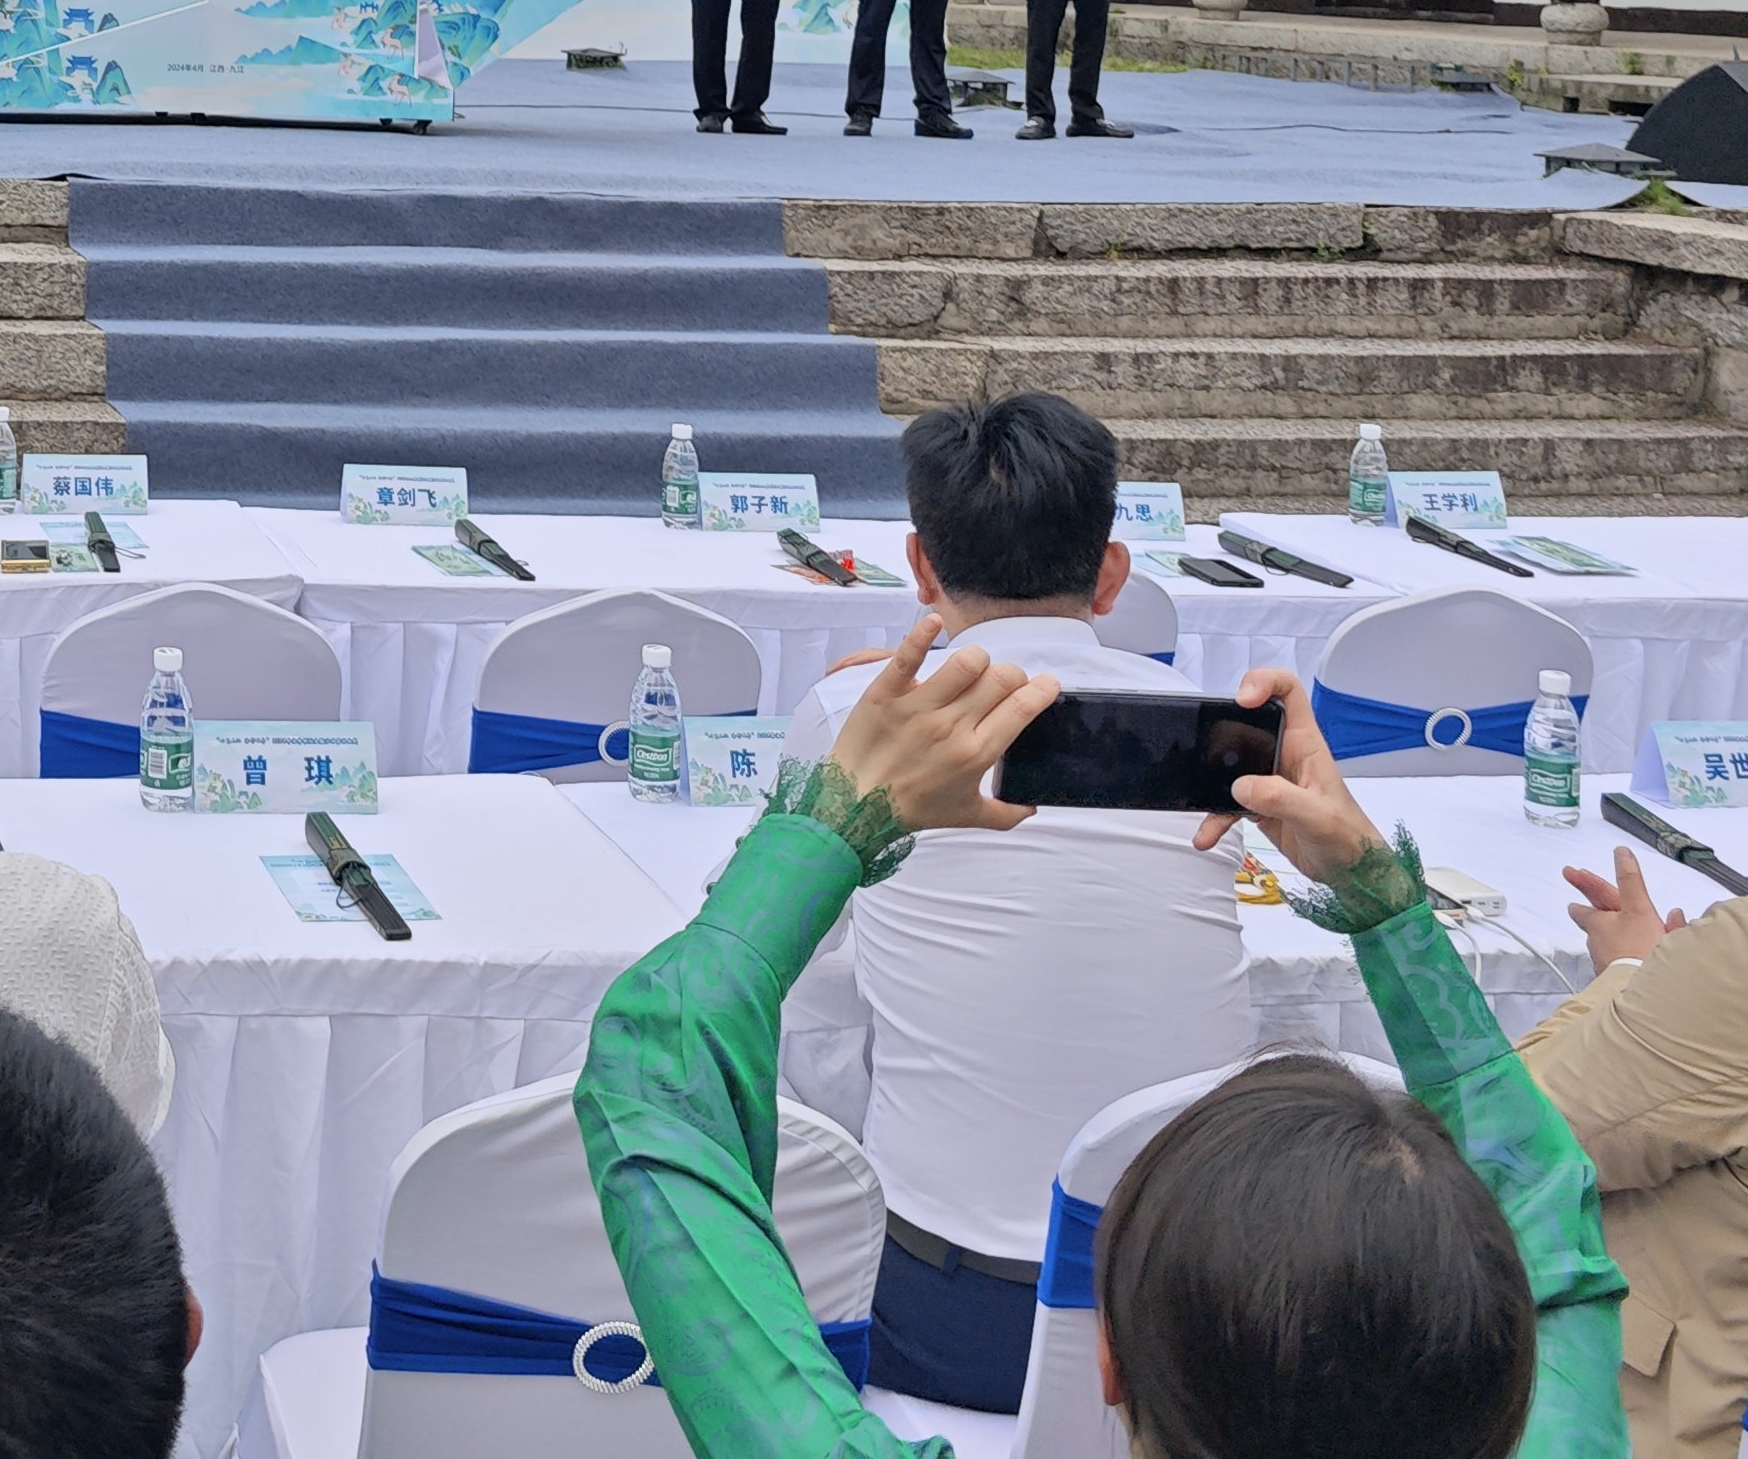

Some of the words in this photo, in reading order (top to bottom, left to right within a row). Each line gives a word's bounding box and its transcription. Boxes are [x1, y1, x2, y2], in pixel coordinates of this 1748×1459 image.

[52, 476, 115, 497] 蔡国伟
[376, 486, 437, 508] 章剑飞
[729, 493, 789, 514] 郭子新
[1422, 492, 1479, 512] 王学利
[242, 754, 268, 787] 曾
[304, 754, 334, 786] 琪
[729, 748, 759, 778] 陈
